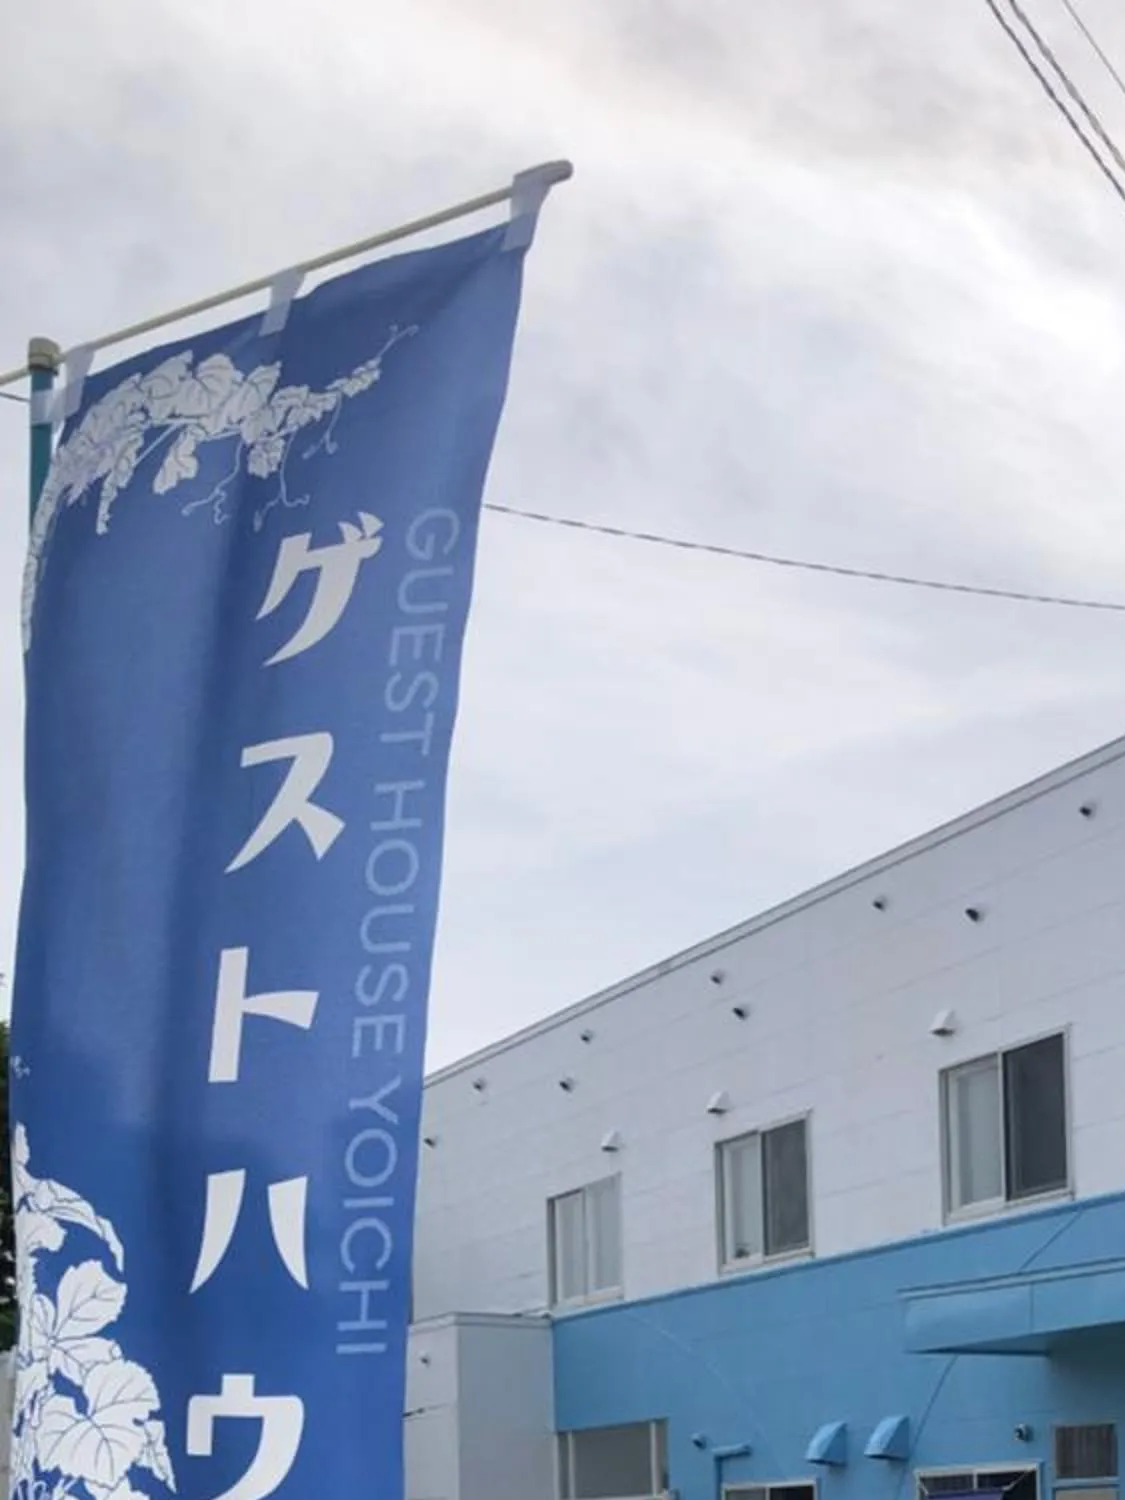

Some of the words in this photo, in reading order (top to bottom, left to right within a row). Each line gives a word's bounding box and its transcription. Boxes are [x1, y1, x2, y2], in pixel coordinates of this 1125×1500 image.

[380, 507, 460, 756] GUEST
[351, 778, 425, 1058] HOUSE
[335, 1079, 403, 1357] YOICHI
